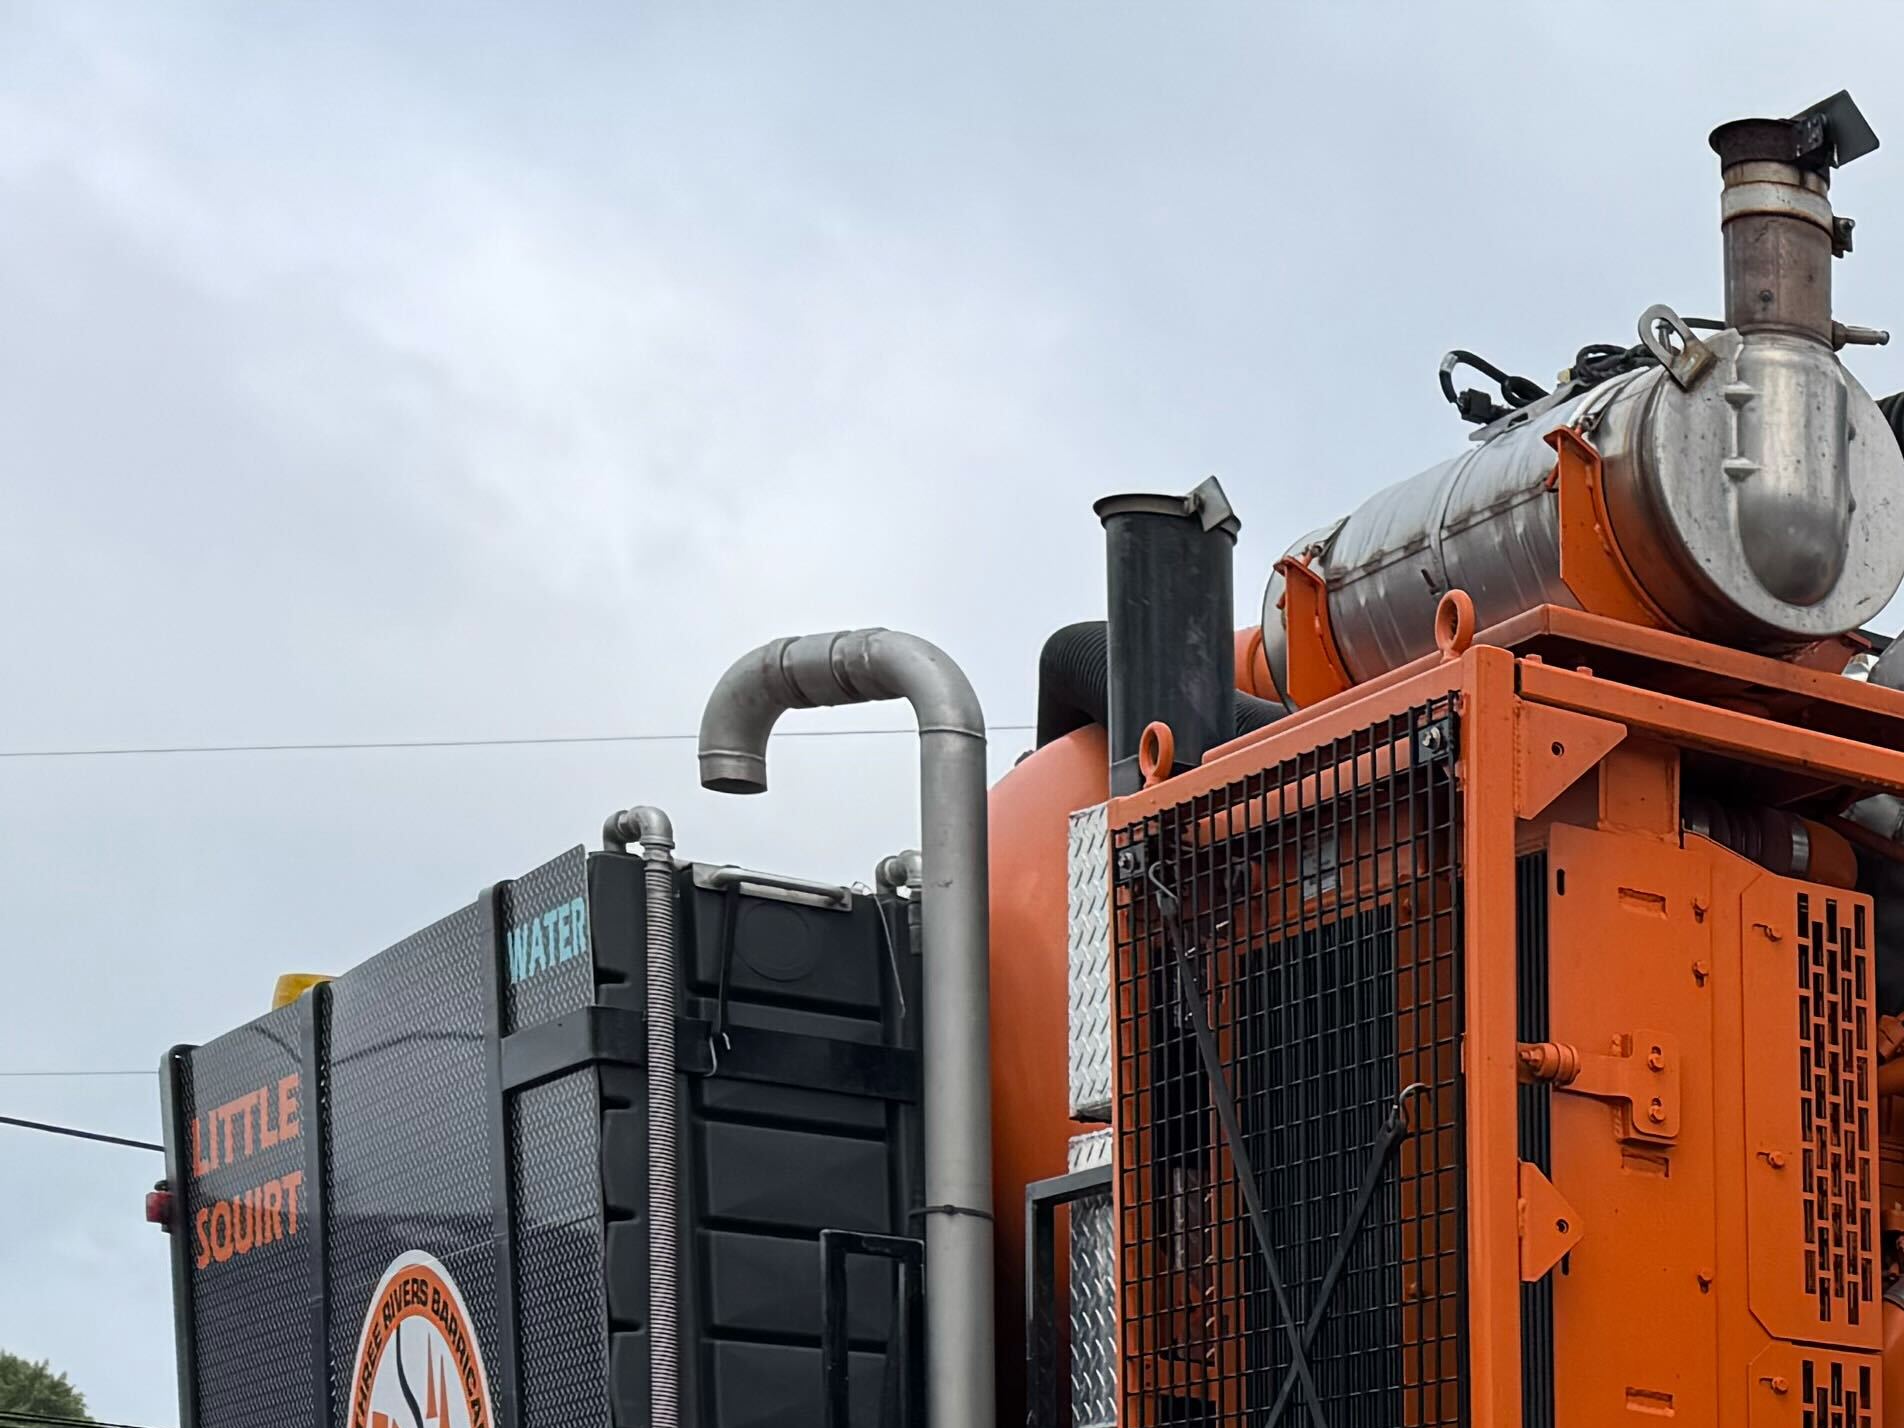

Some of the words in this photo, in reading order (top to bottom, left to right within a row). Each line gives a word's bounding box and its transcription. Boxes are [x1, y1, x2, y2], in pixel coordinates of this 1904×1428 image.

[507, 896, 586, 984] WATER
[192, 1072, 300, 1177] LITTLE
[382, 1277, 428, 1331] RIVERS
